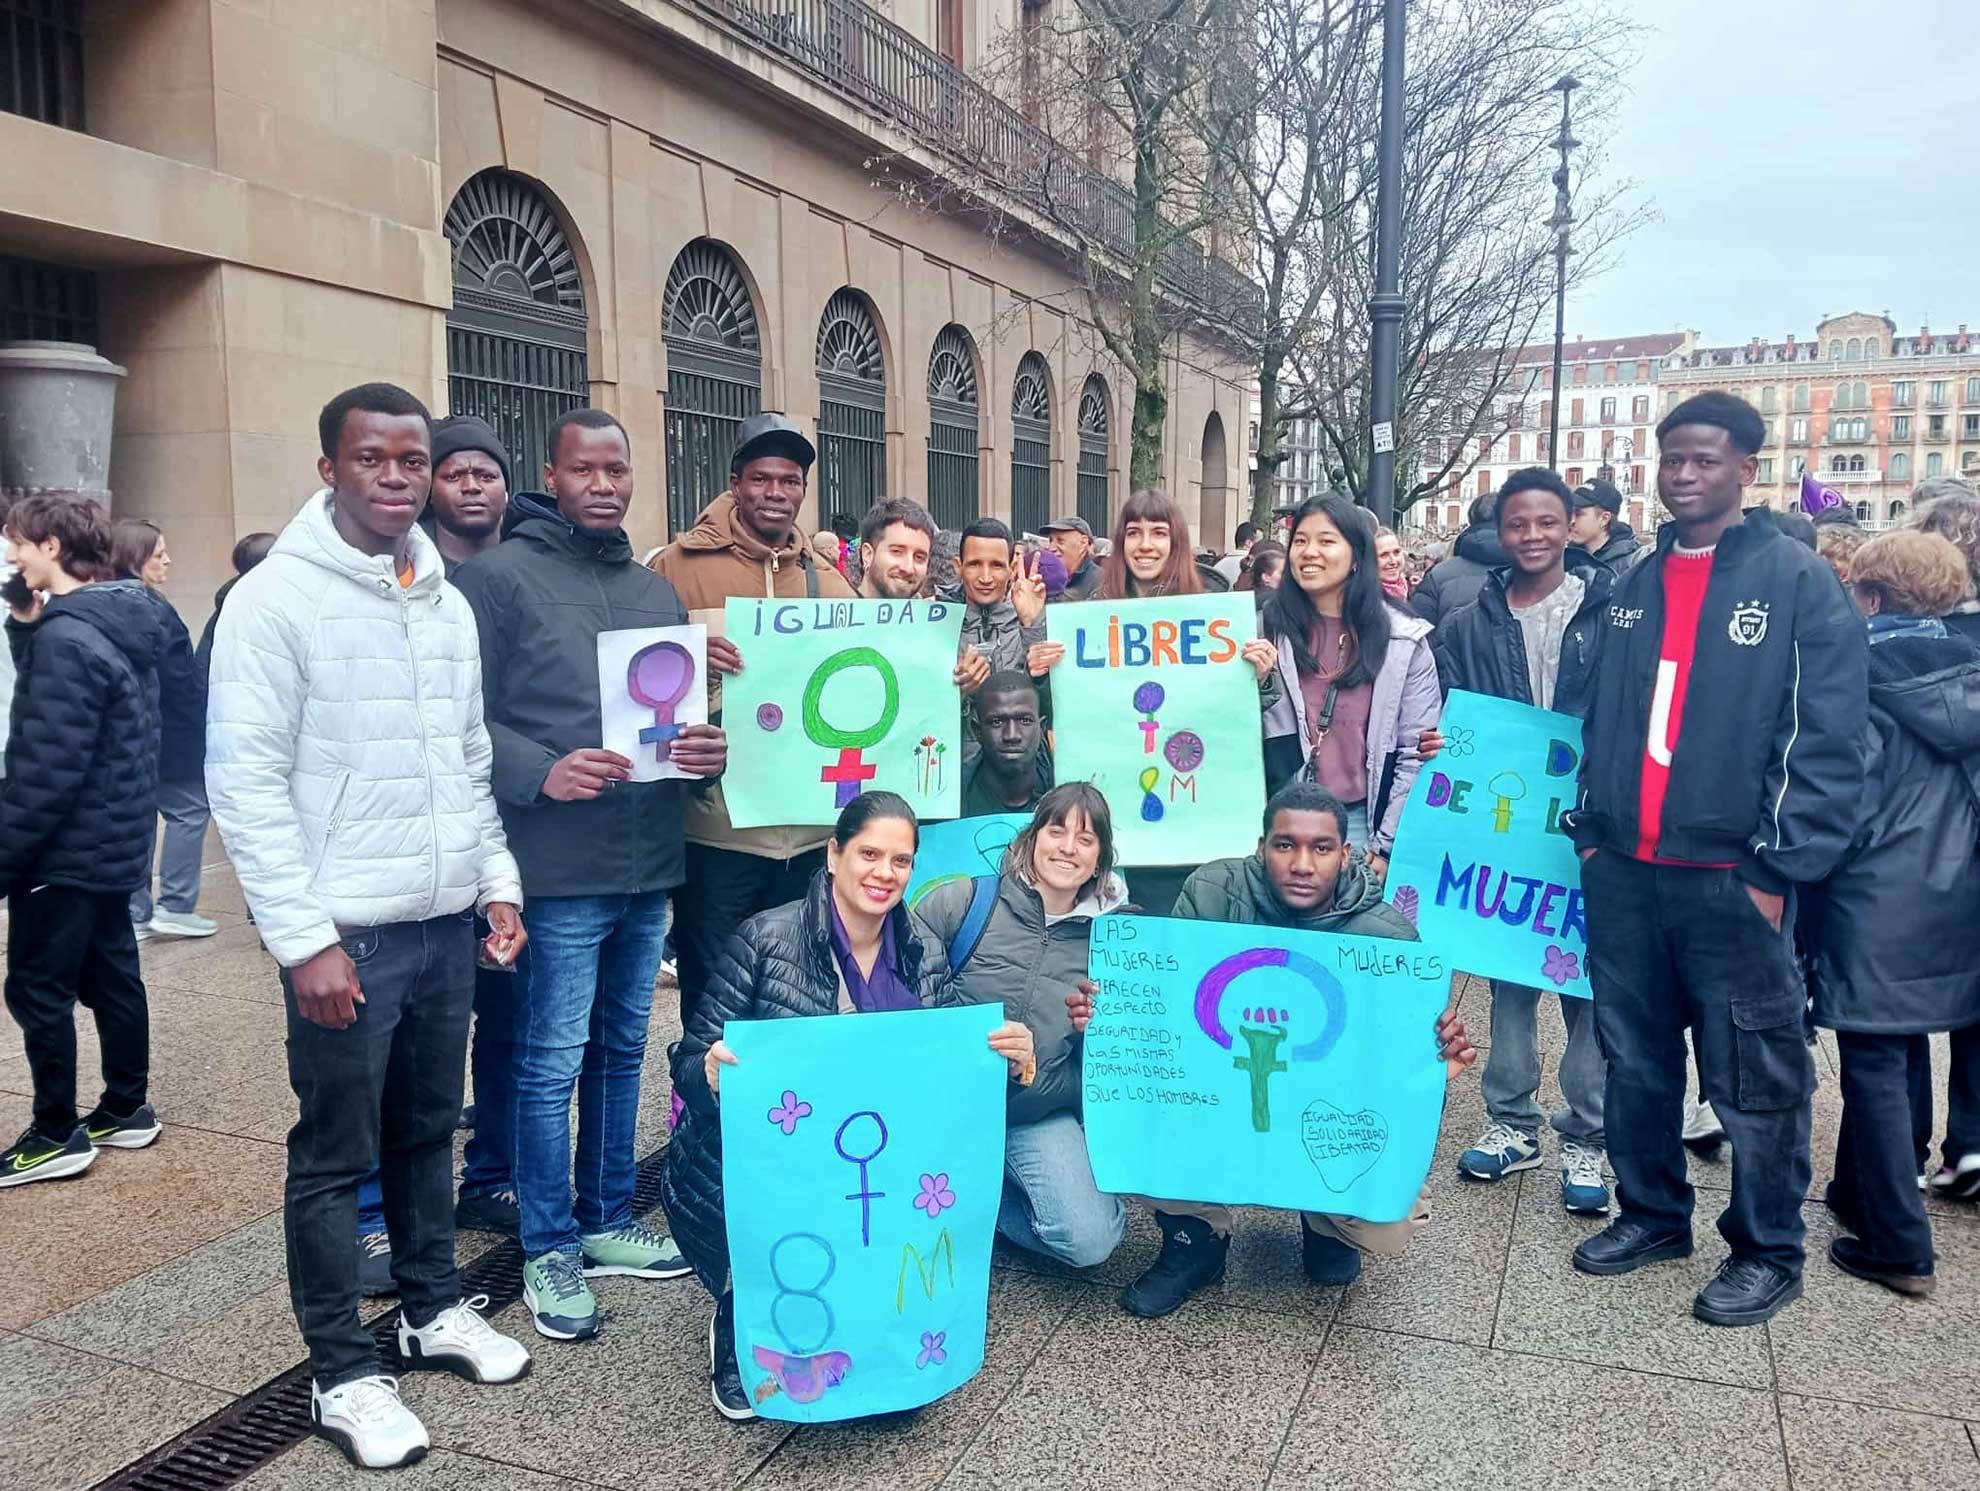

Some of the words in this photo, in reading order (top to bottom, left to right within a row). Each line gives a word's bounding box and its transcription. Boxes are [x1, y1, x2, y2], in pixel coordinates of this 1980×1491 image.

[1426, 772, 1474, 815] DE
[1094, 919, 1138, 944] LAS
[1090, 948, 1180, 973] MUJERES
[1337, 944, 1444, 980] MUJERES
[1126, 1085, 1154, 1104] LOS
[1303, 1111, 1374, 1127] IGUALDAD
